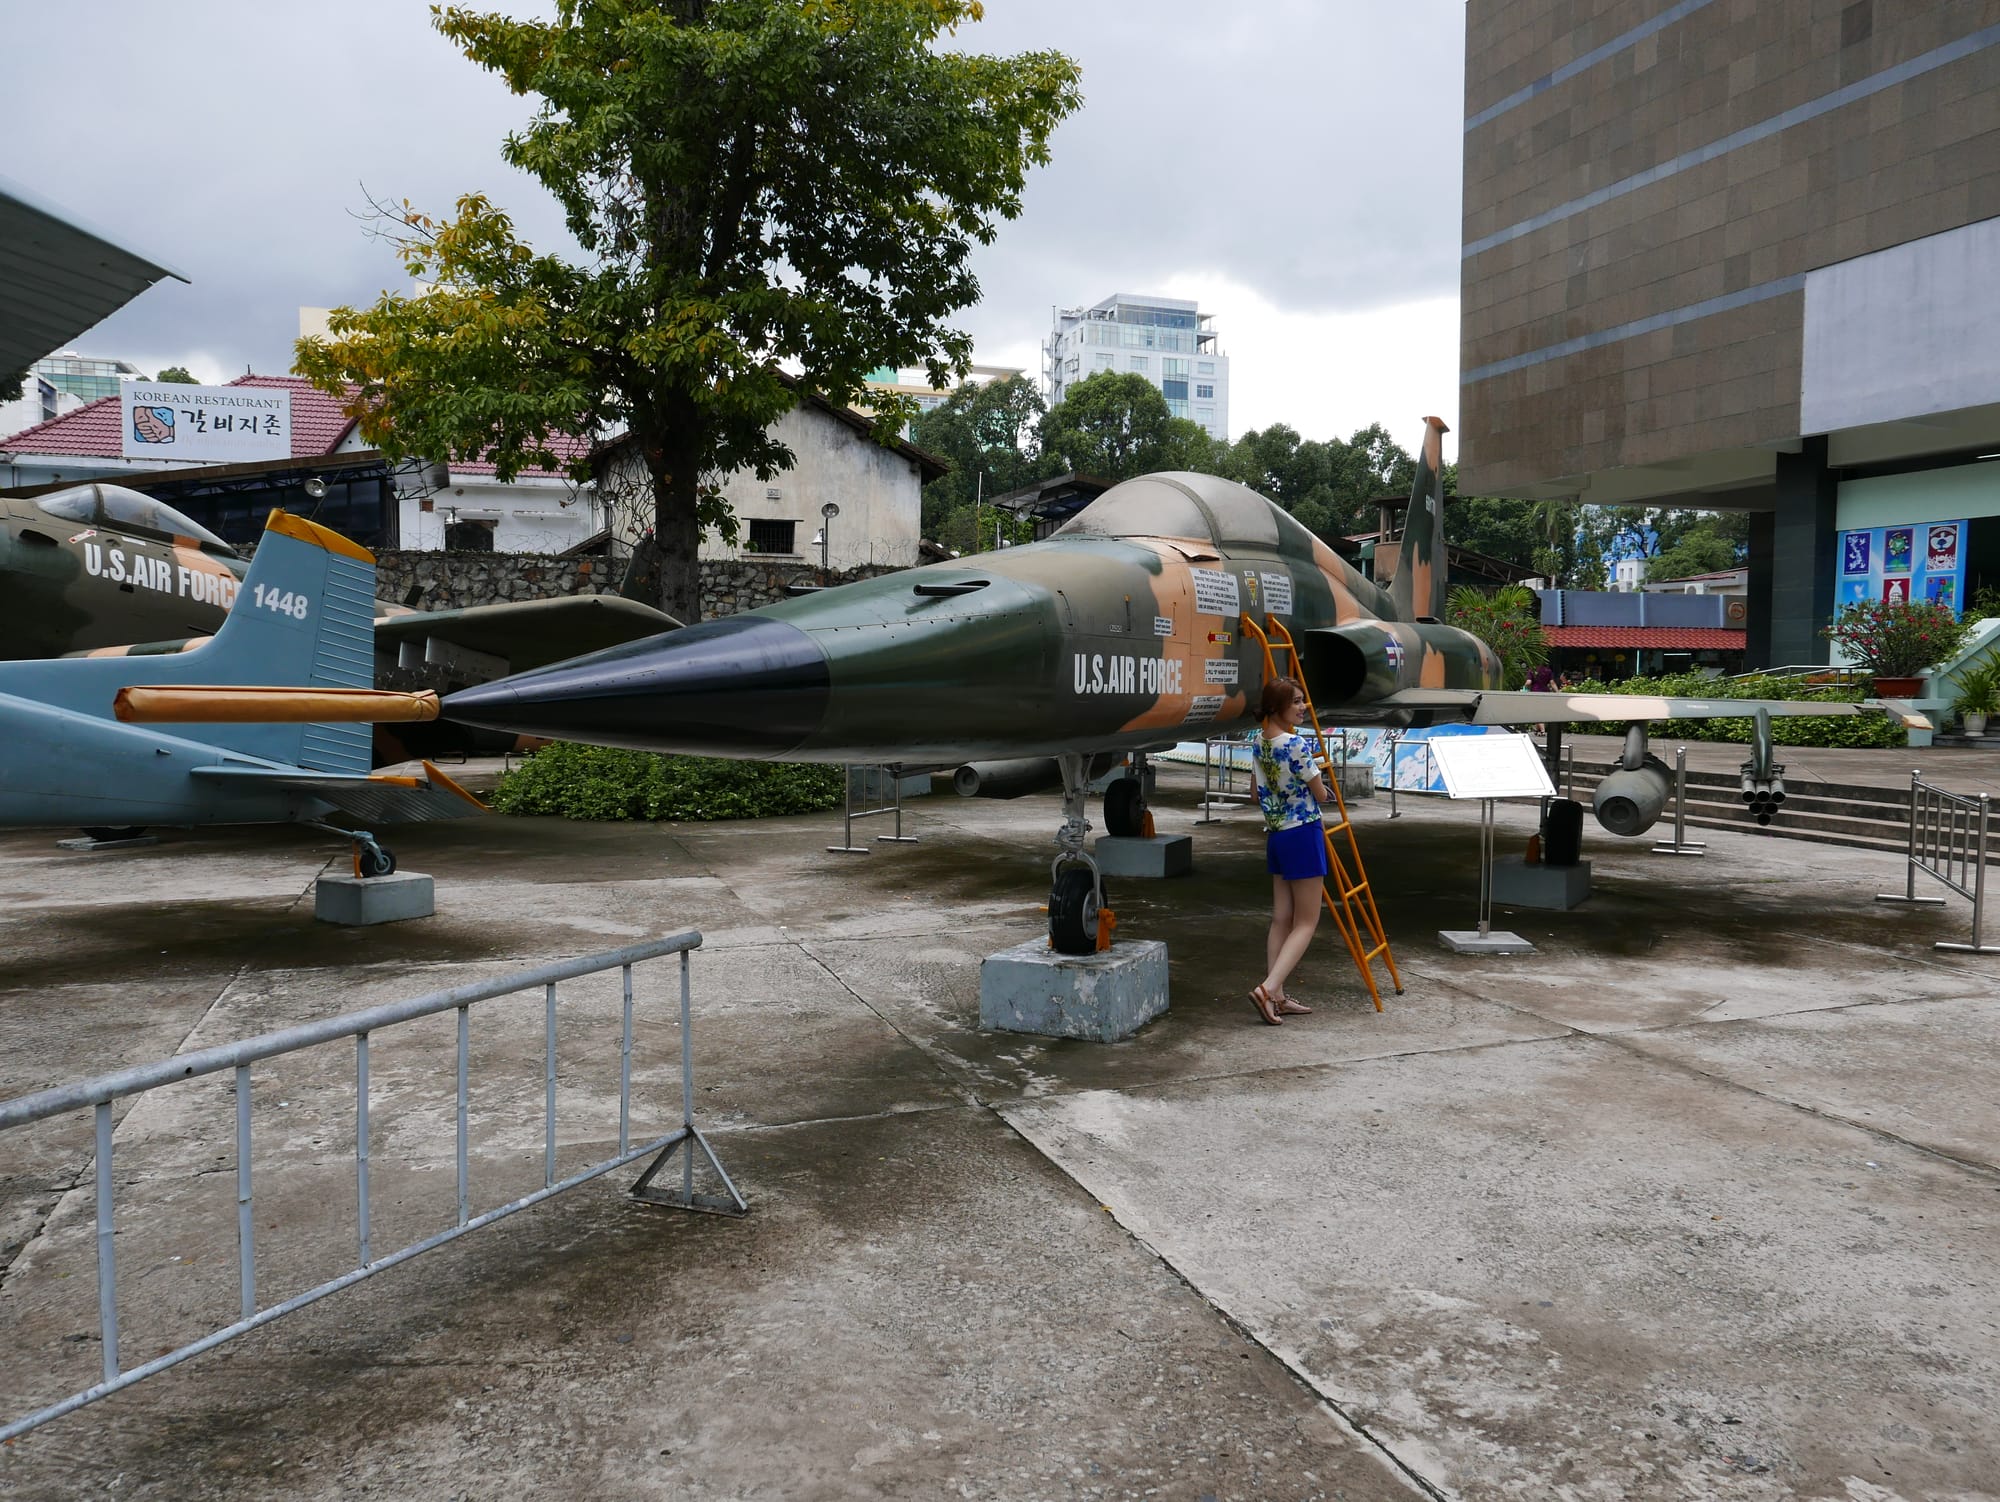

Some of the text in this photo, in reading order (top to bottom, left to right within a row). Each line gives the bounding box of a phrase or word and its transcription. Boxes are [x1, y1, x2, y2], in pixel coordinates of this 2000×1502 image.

[133, 391, 283, 409] KOREAN RESTAURANT
[181, 409, 281, 436] 갈비지존
[254, 583, 309, 620] 1448
[1140, 657, 1183, 695] FORCE
